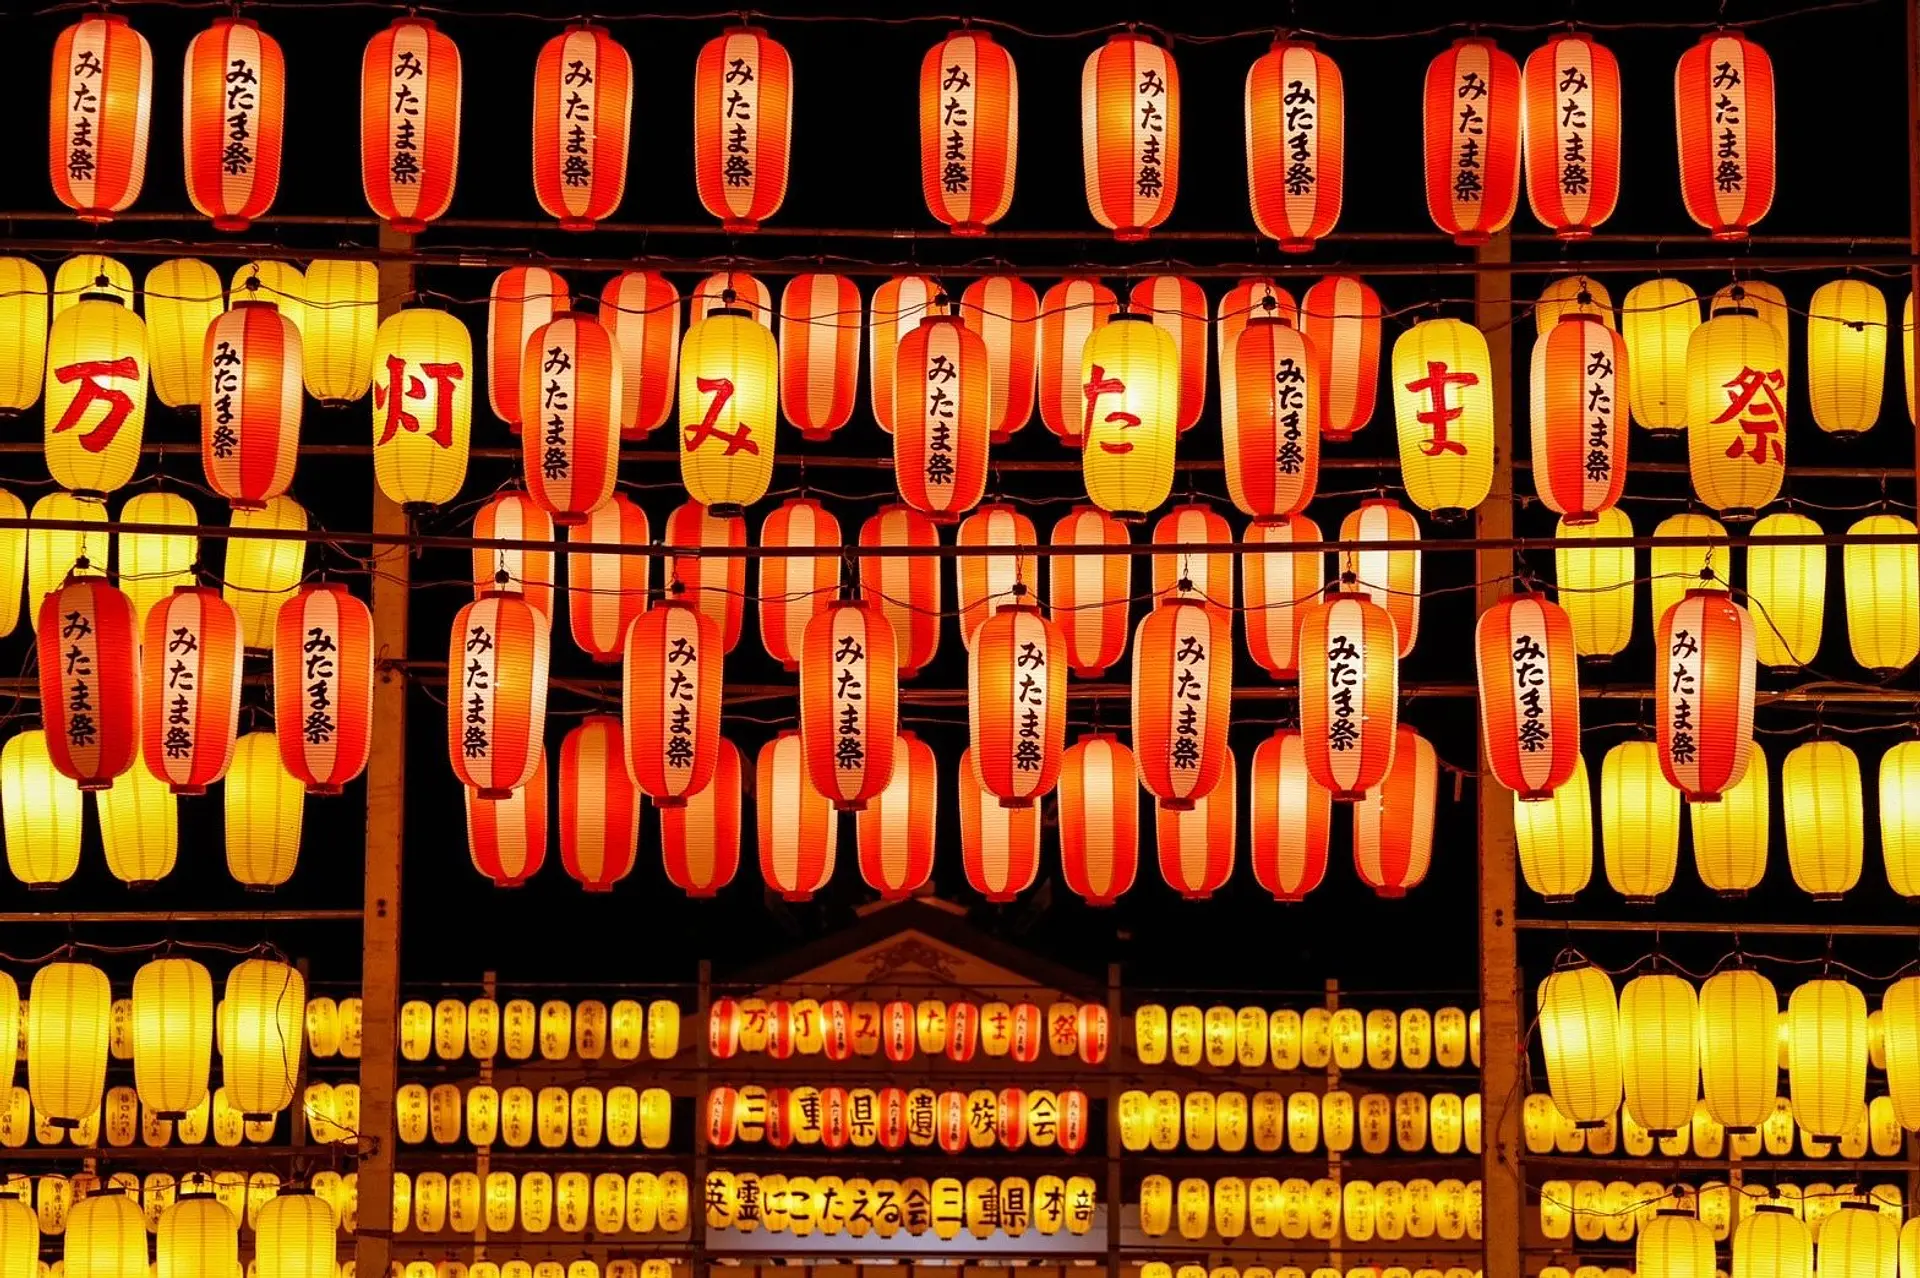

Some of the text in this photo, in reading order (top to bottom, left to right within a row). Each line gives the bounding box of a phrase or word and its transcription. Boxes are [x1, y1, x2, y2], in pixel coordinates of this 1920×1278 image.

[69, 52, 101, 180] みたま祭
[222, 60, 257, 175] みたま祭
[391, 52, 422, 184] みたま祭
[563, 61, 592, 186] みたま祭
[725, 59, 753, 187] みたま祭
[942, 65, 970, 193] みたま祭
[1137, 70, 1164, 197] みたま祭
[1284, 81, 1315, 195] みたま祭
[1454, 73, 1486, 201] みたま祭
[1560, 67, 1588, 195] みたま祭
[1714, 62, 1743, 193] みたま祭
[53, 356, 1786, 465] 万 灯 み た ま 祭
[213, 342, 240, 458] みたま祭
[543, 347, 571, 480] みたま祭
[927, 356, 956, 484] みたま祭
[1277, 359, 1304, 474] みたま祭
[1585, 351, 1612, 481] みたま祭
[64, 612, 96, 746] みたま祭
[164, 628, 197, 758] みたま祭
[304, 628, 336, 744] みたま祭
[463, 626, 492, 758] みたま祭
[666, 638, 696, 768] みたま祭
[836, 636, 864, 769] みたま祭
[1014, 643, 1044, 771] みたま祭
[1171, 637, 1204, 769] みたま祭
[1328, 636, 1360, 751] みたま祭
[1513, 636, 1549, 752] みたま祭
[1671, 630, 1697, 764] みたま祭
